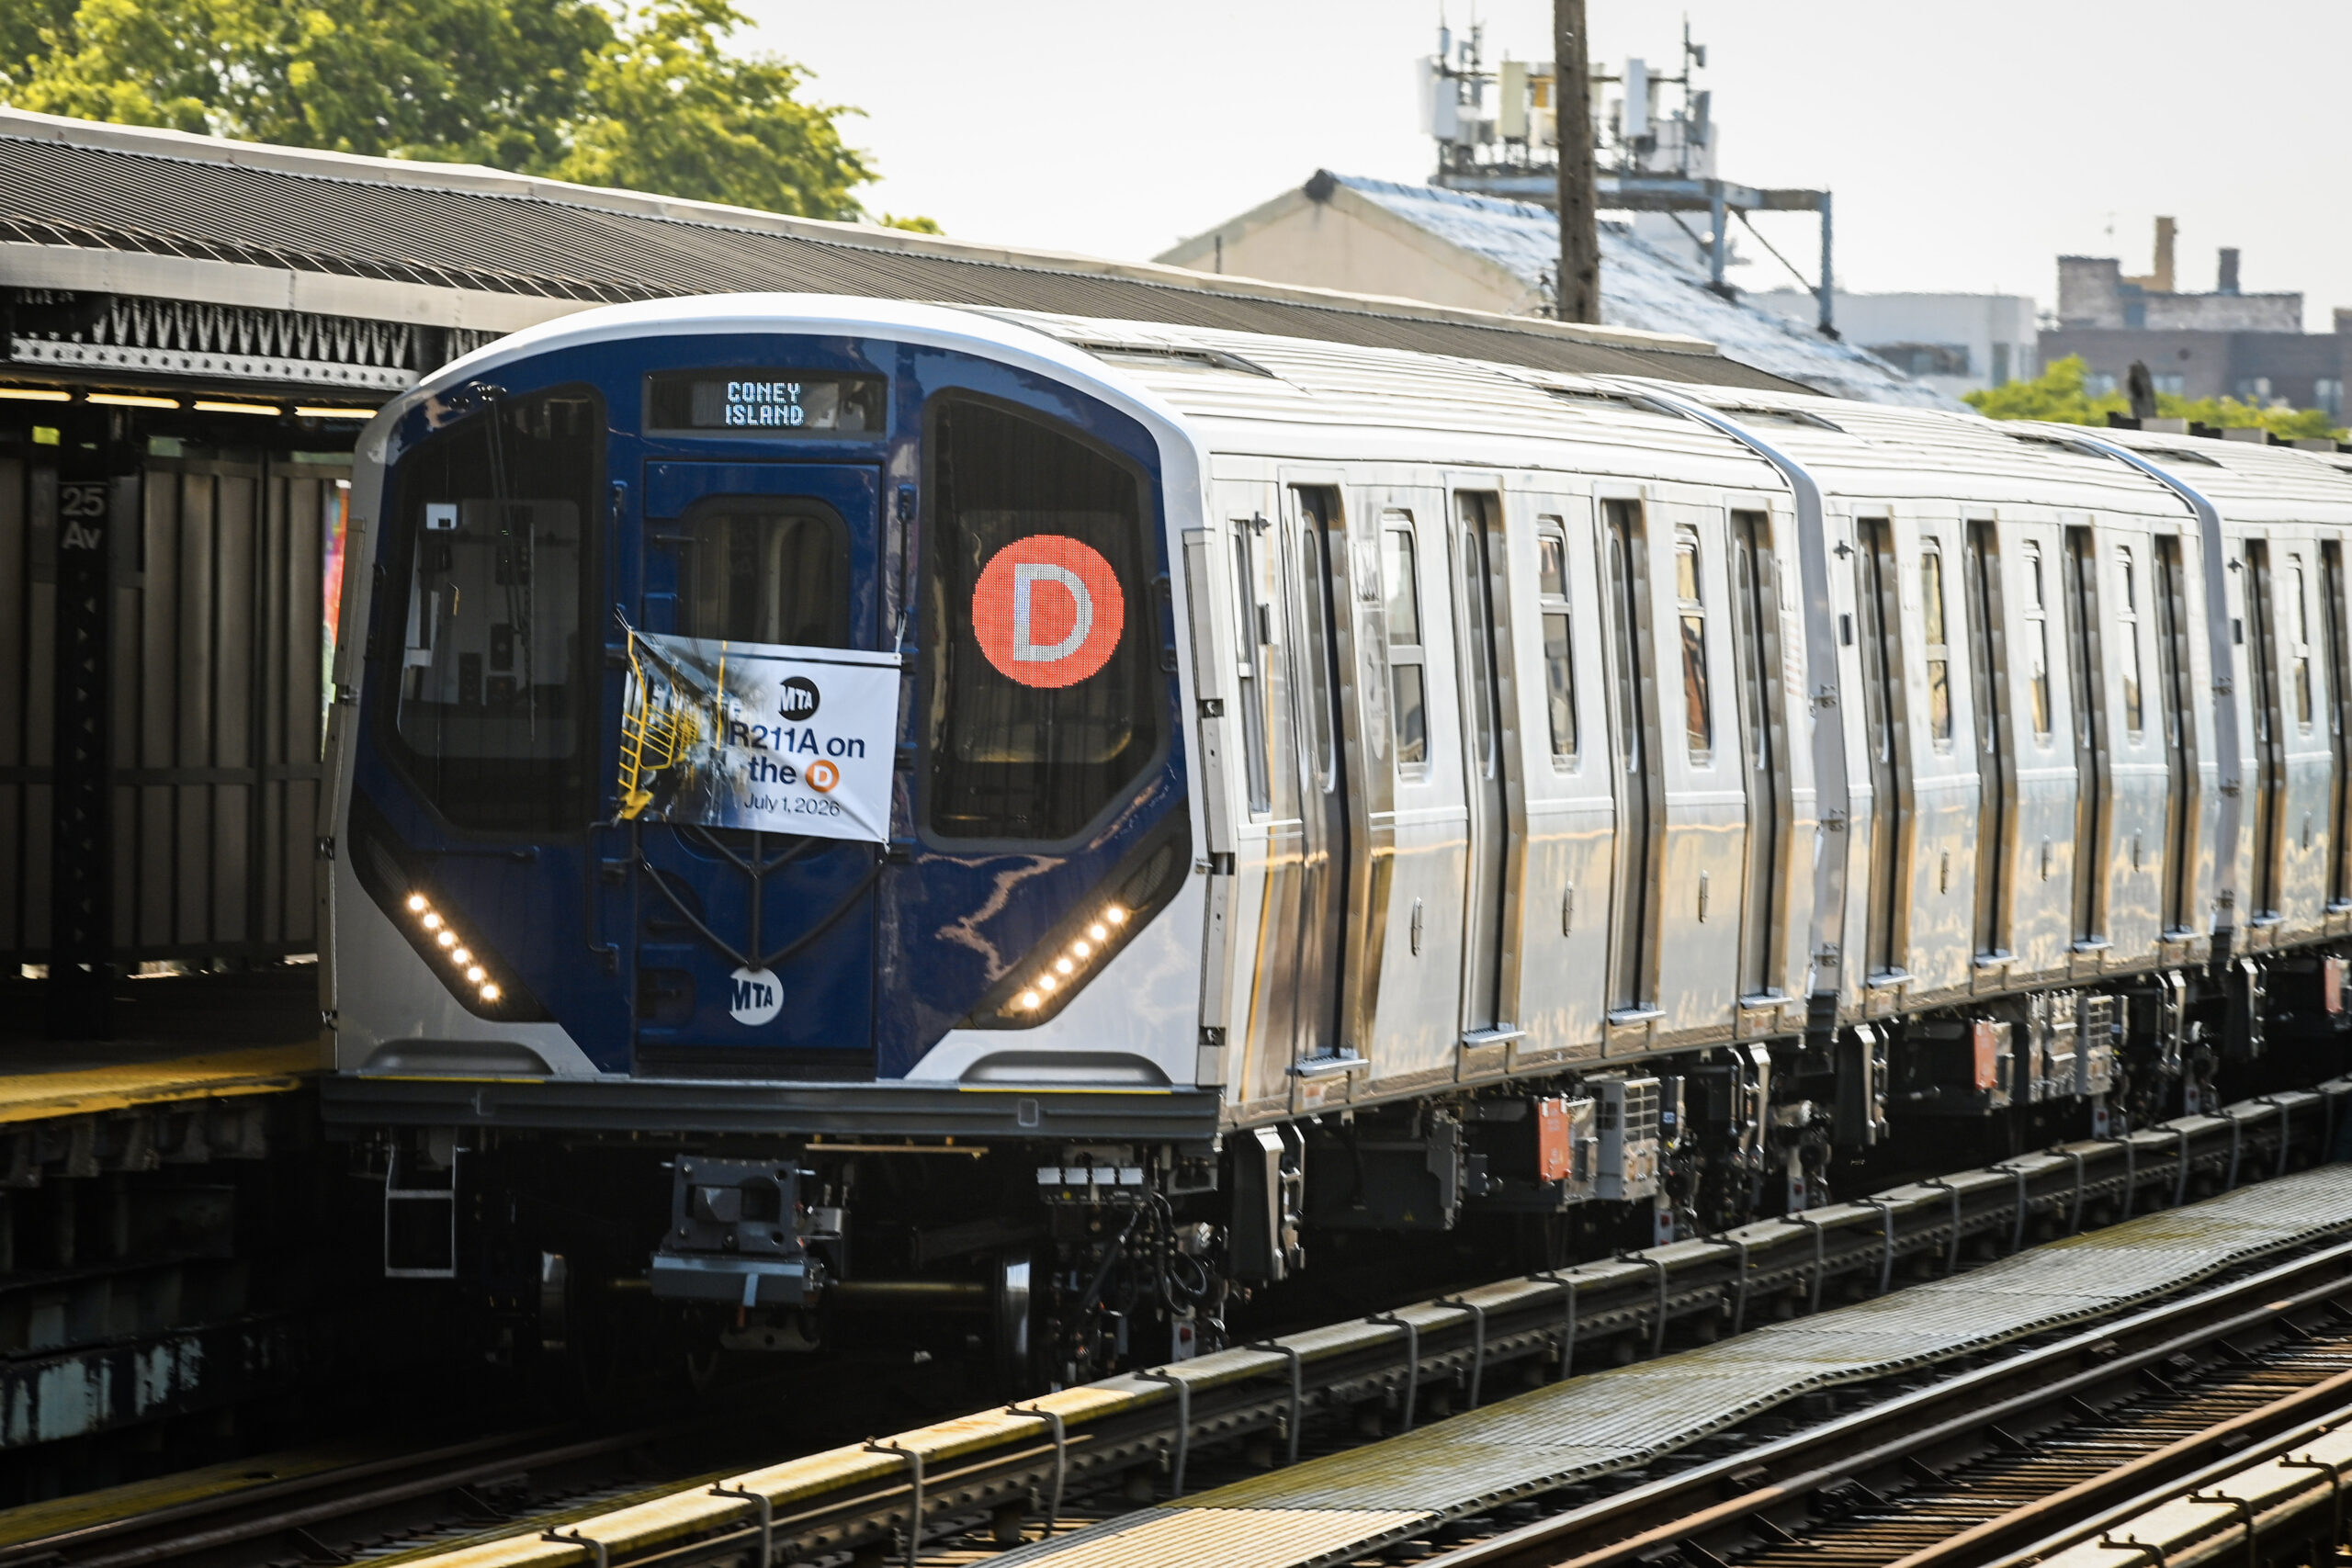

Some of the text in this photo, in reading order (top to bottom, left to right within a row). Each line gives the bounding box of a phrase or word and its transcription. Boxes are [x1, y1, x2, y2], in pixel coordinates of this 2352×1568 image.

[727, 381, 801, 403] CONEY
[725, 404, 805, 426] ISLAND
[61, 487, 105, 517] 25
[61, 521, 102, 549] Av
[1012, 562, 1093, 662] D
[779, 685, 814, 712] MTA
[729, 721, 865, 759] R211A on
[748, 756, 832, 787] the D
[744, 794, 841, 817] July 1, 2026
[730, 978, 774, 1010] MTA
